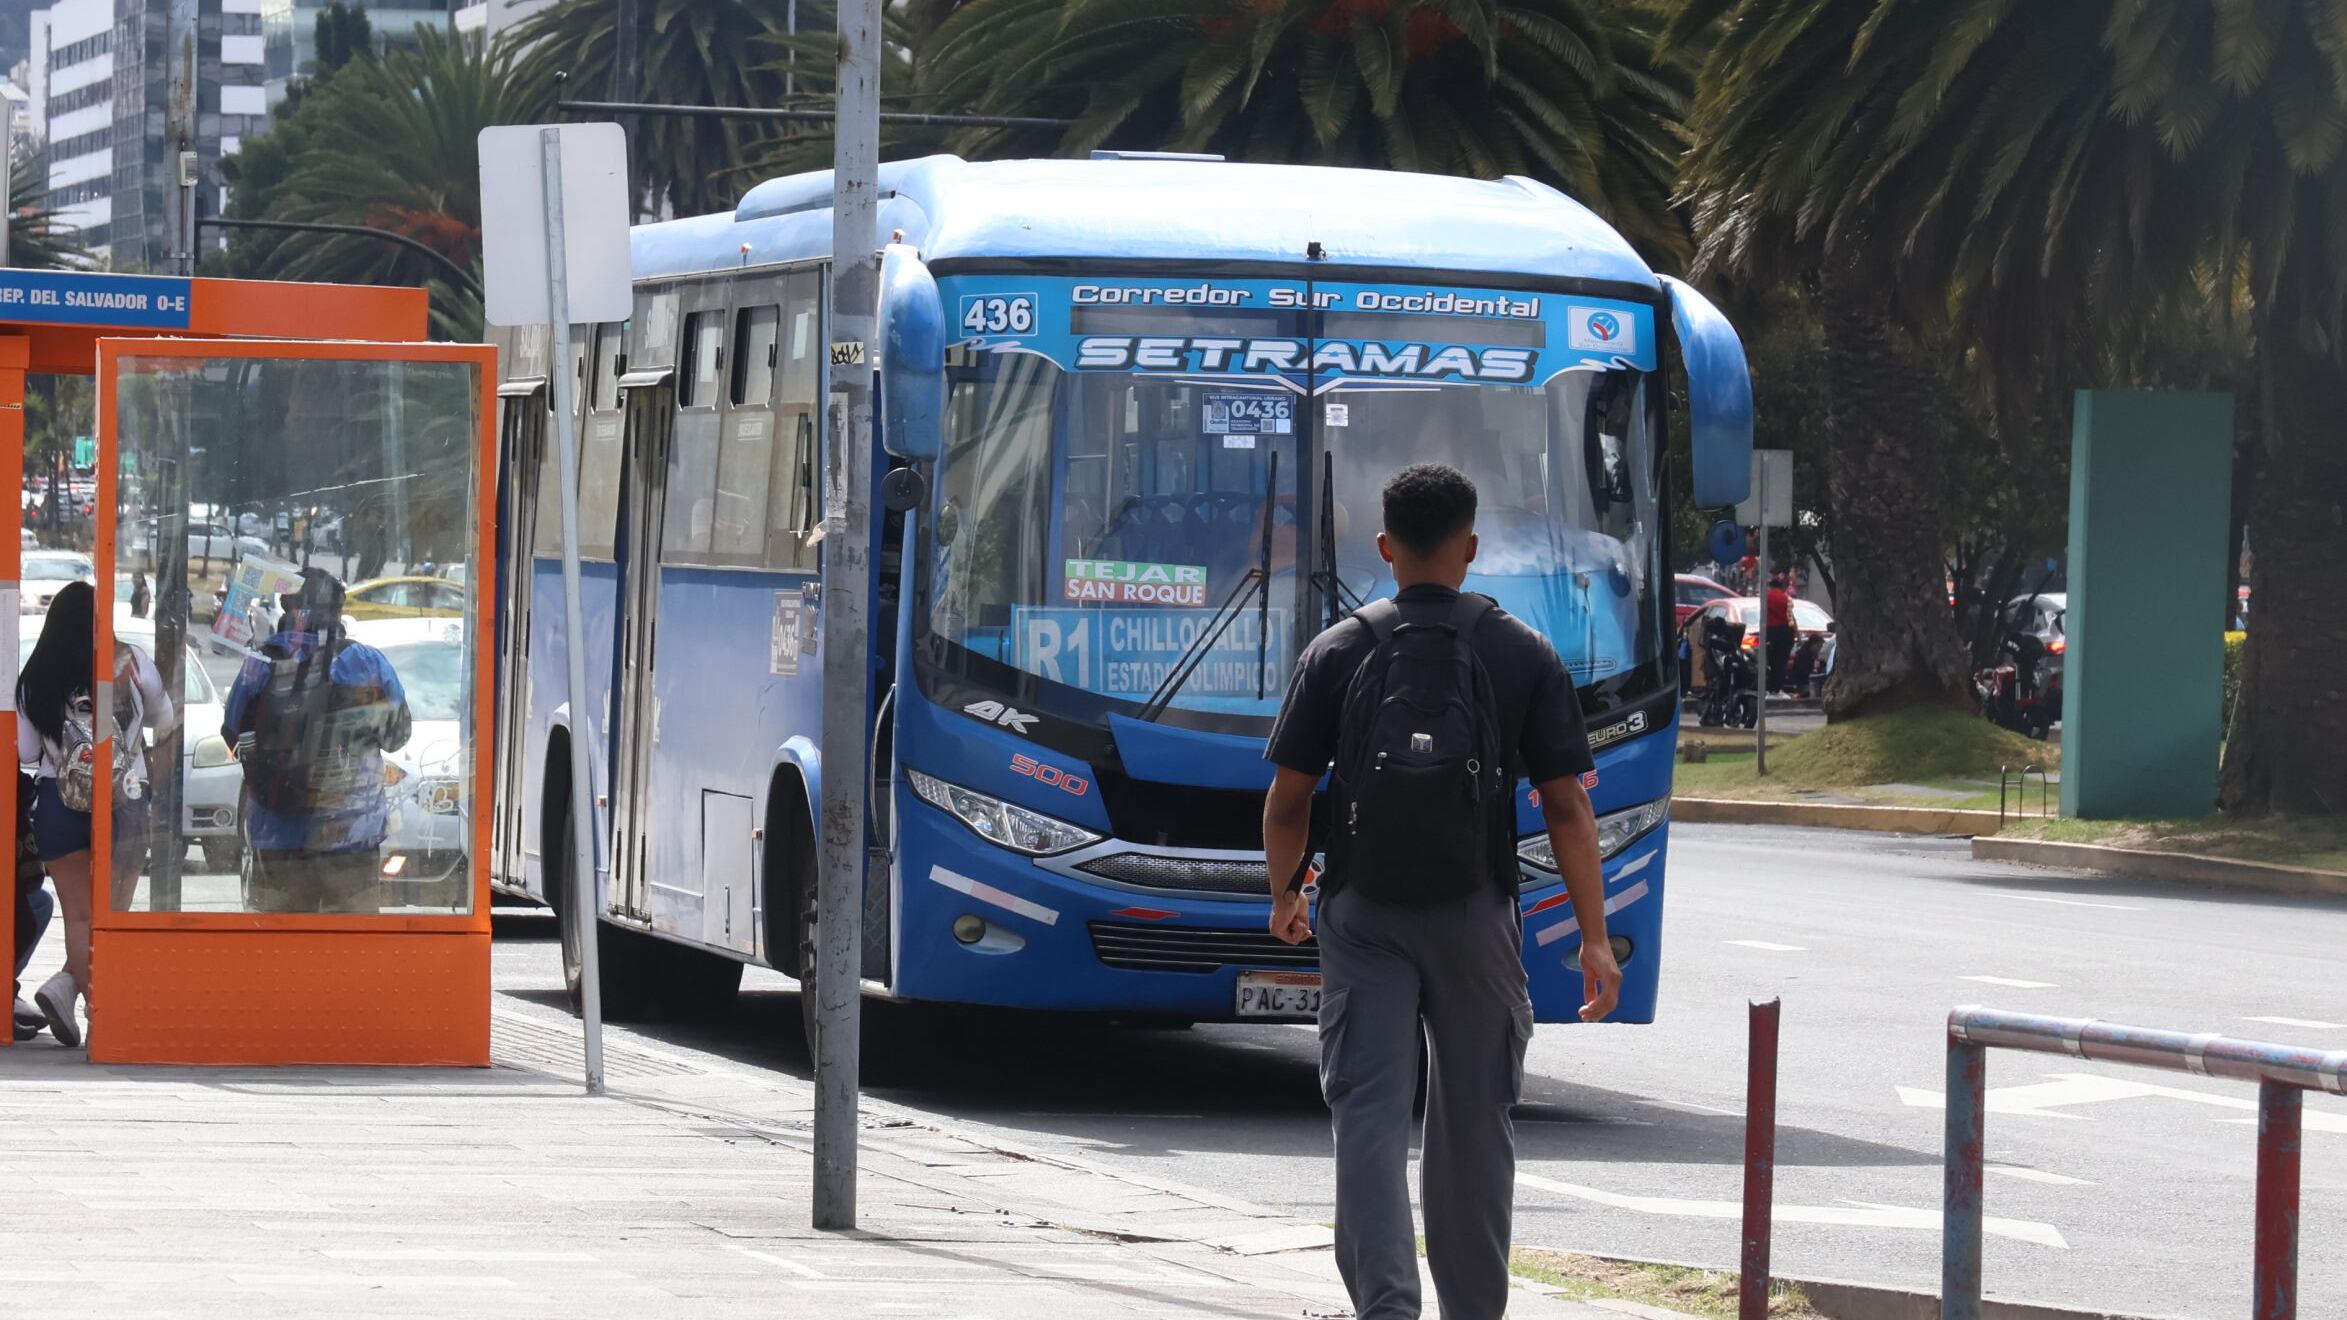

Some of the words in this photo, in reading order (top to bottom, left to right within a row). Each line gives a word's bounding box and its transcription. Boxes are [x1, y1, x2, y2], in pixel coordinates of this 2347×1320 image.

[30, 289, 60, 306] DEL
[65, 291, 147, 310] SALVADOR
[964, 298, 1032, 332] 436
[1072, 284, 1252, 305] Corredor
[1268, 288, 1341, 308] Sur
[1356, 291, 1539, 318] Occidental
[1076, 337, 1534, 379] SETRAMAS
[1231, 400, 1289, 419] 0436
[1068, 561, 1201, 583] TEJAR
[1067, 579, 1115, 600] SAN
[1124, 583, 1204, 605] ROQUE
[1028, 617, 1090, 689] R1
[963, 700, 1040, 735] AK
[1009, 753, 1089, 796] 500
